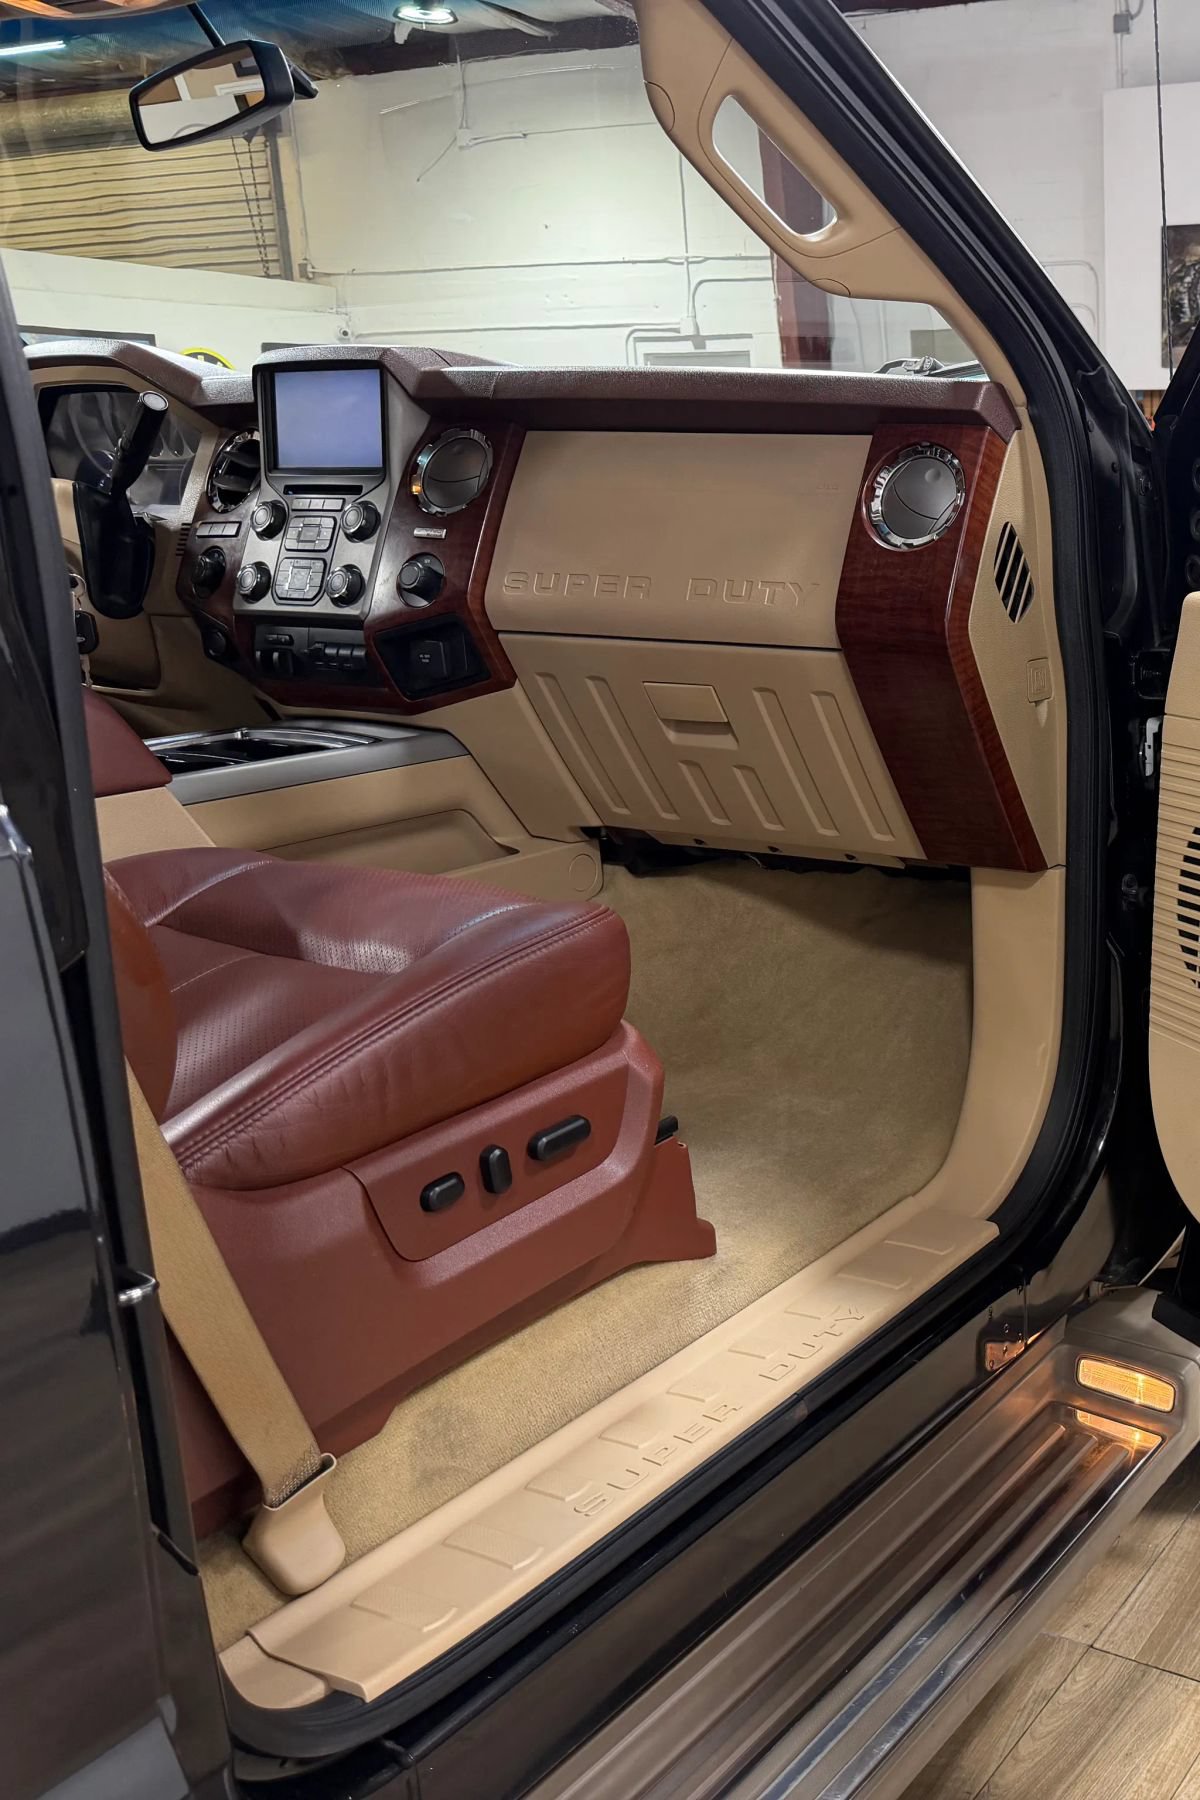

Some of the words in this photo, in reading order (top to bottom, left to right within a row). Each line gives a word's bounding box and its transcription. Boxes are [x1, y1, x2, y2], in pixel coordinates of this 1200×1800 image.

[503, 571, 652, 600] SUPER
[686, 577, 822, 608] DUTY
[573, 1402, 744, 1517] SUPER
[758, 1306, 865, 1382] DUTY
